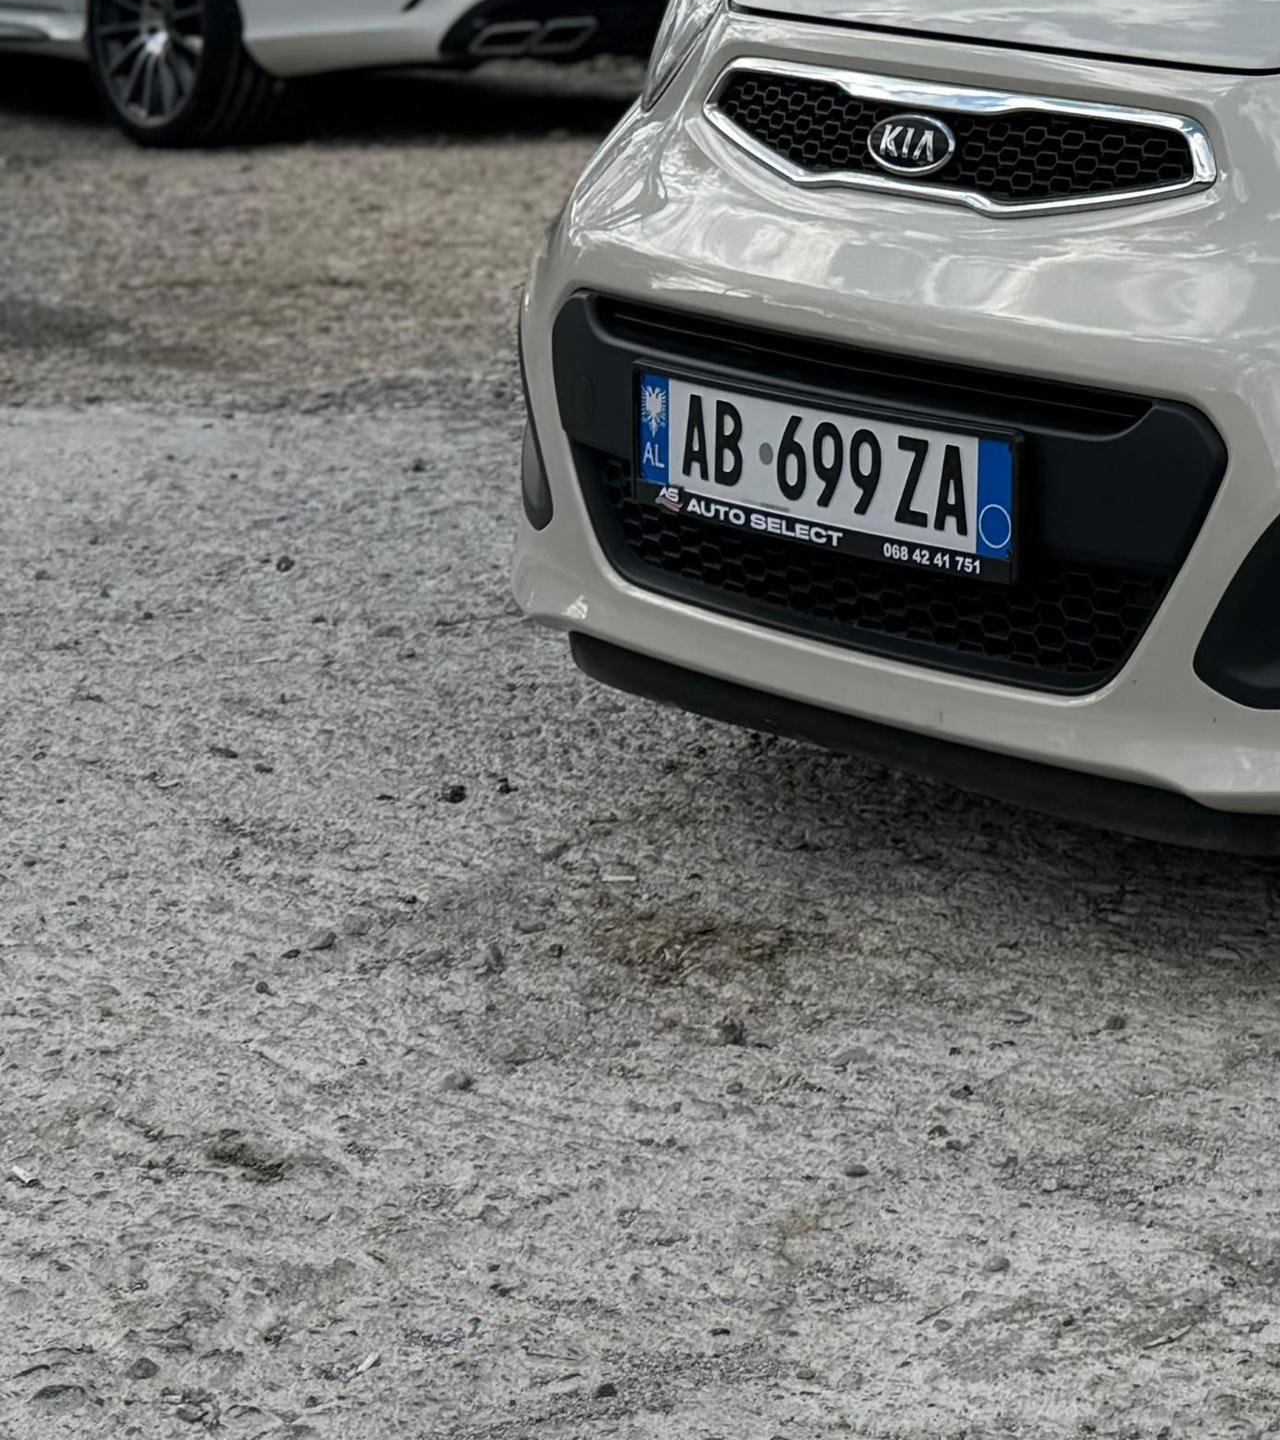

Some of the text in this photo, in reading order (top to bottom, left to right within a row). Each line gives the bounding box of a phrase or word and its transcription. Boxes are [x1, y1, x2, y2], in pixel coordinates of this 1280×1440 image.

[879, 123, 935, 163] KIA
[643, 441, 665, 470] AL
[682, 393, 968, 537] AB 699 ZA
[686, 497, 844, 548] AUTO SELECT
[883, 542, 981, 575] 068 42 41 751
